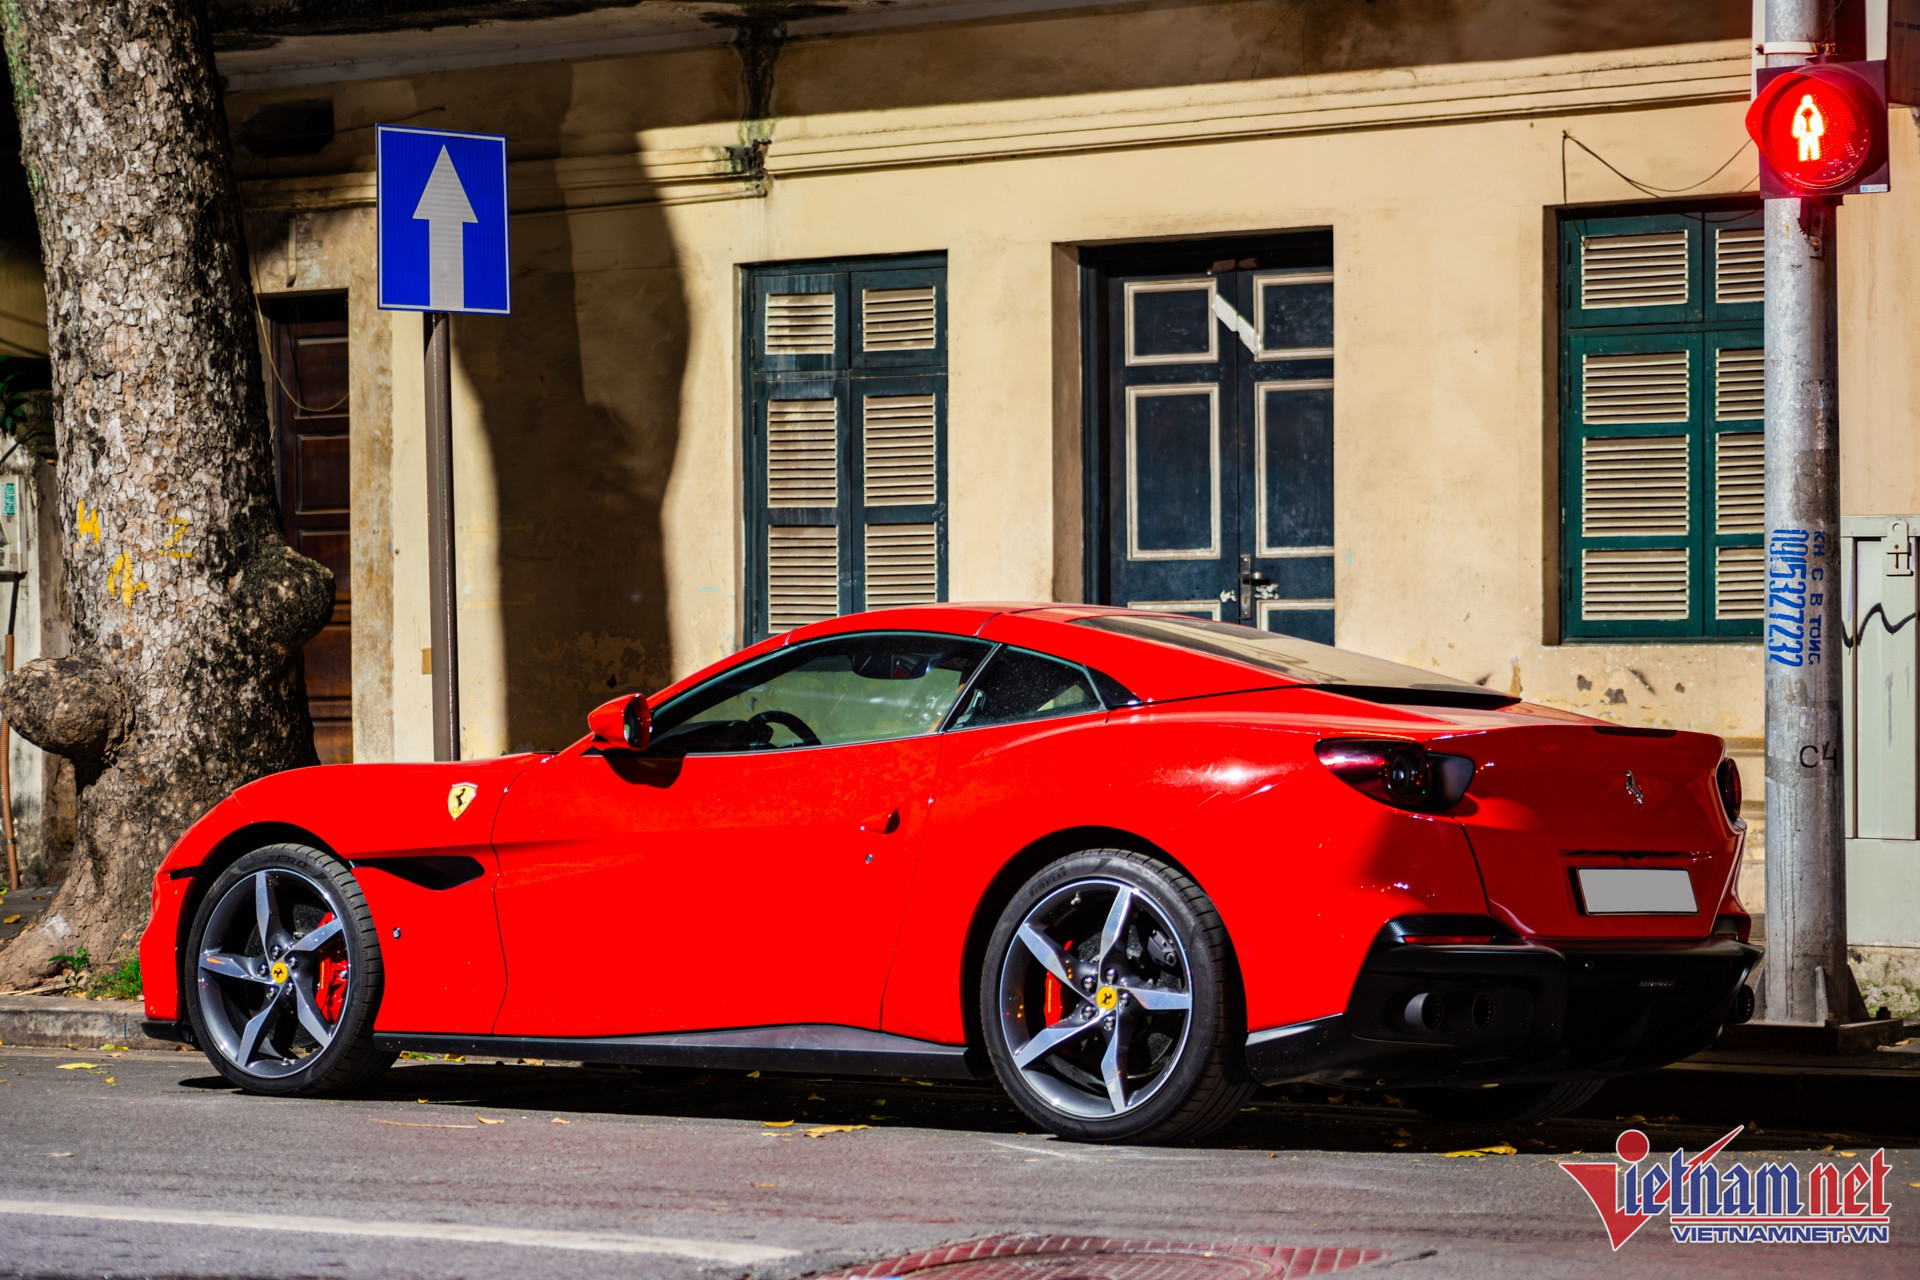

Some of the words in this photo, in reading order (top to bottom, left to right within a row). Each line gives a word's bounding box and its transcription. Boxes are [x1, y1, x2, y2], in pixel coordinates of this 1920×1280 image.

[1812, 530, 1826, 557] KH
[1811, 567, 1824, 581] C
[1810, 593, 1824, 606] B
[1799, 741, 1838, 771] C4
